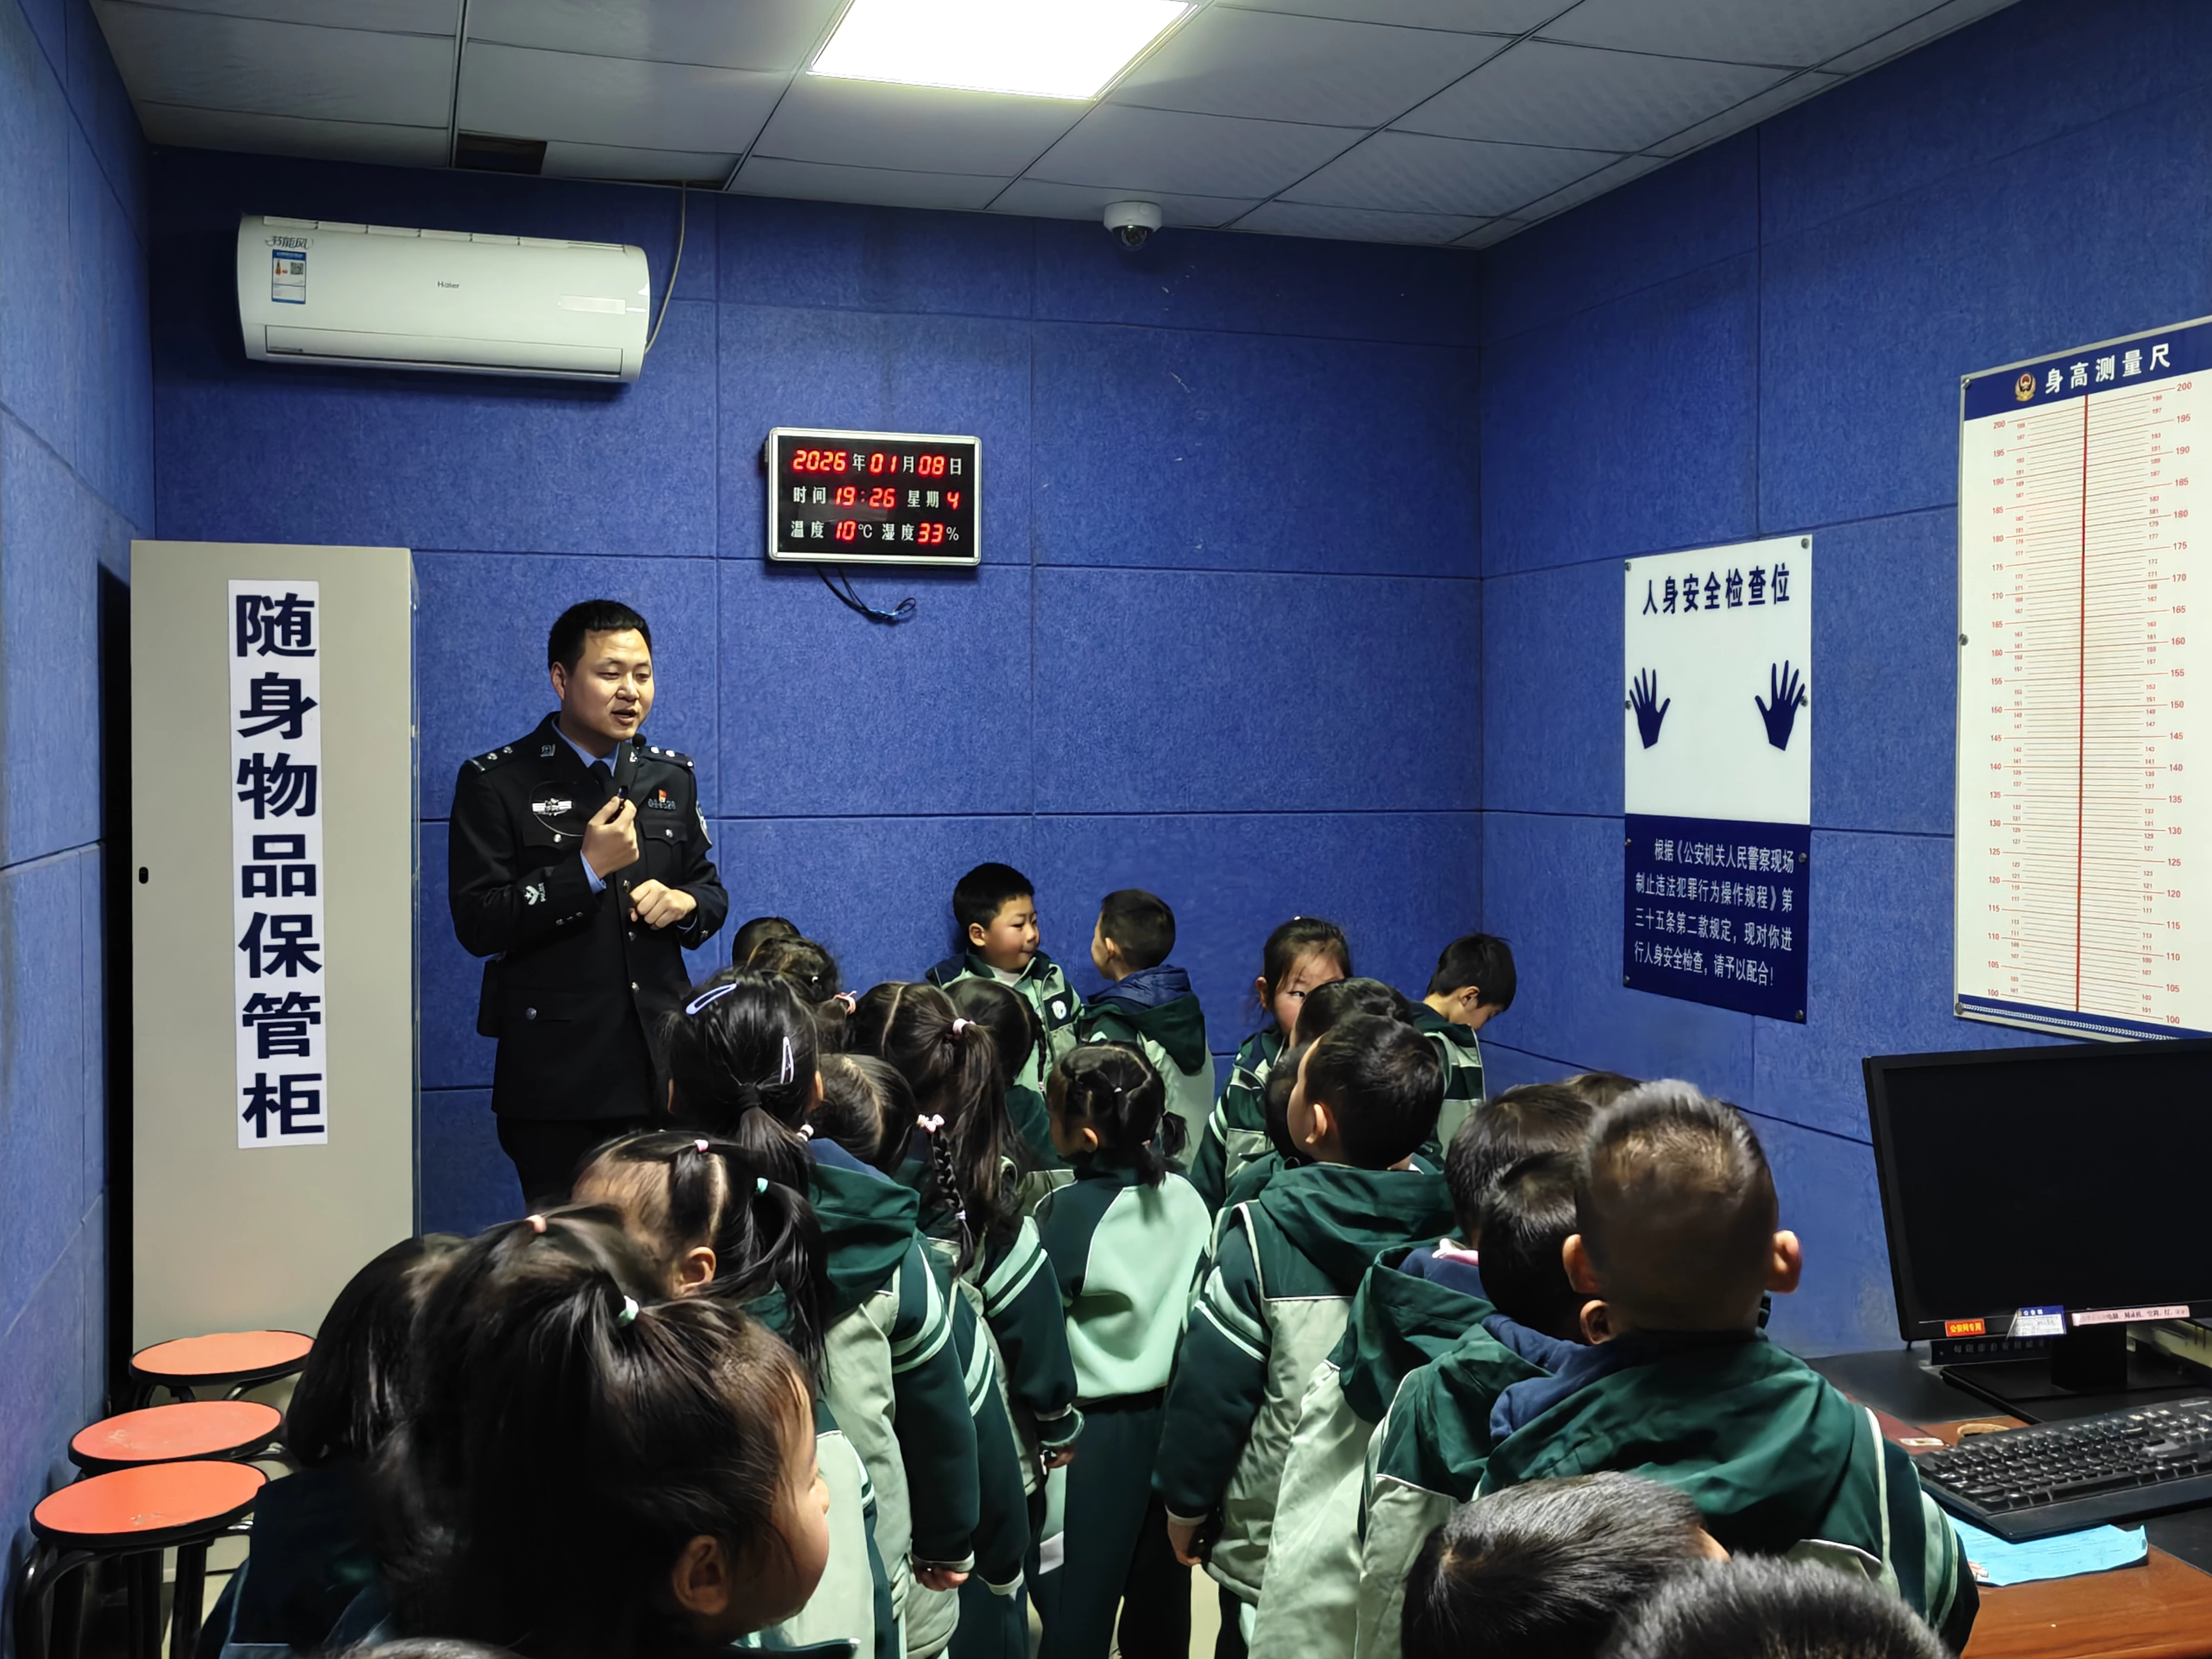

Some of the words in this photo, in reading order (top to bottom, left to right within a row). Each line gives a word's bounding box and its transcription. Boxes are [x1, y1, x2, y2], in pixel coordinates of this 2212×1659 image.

[2045, 343, 2170, 394] 身高测量尺
[2177, 382, 2191, 391] 200
[2176, 414, 2191, 423] 195
[1993, 421, 2005, 429] 200
[1993, 449, 2005, 457] 195
[2175, 446, 2190, 455] 190
[1993, 478, 2005, 486] 190
[2175, 478, 2189, 487] 185
[1642, 562, 1790, 616] 人身安全检查位
[1655, 839, 1794, 873] 根据《公安机关人民警察现场
[235, 593, 323, 1138] 随身物品保管柜
[1635, 872, 1793, 913] 制止违法犯罪行为操作规程》第
[2166, 1015, 2180, 1024] 100
